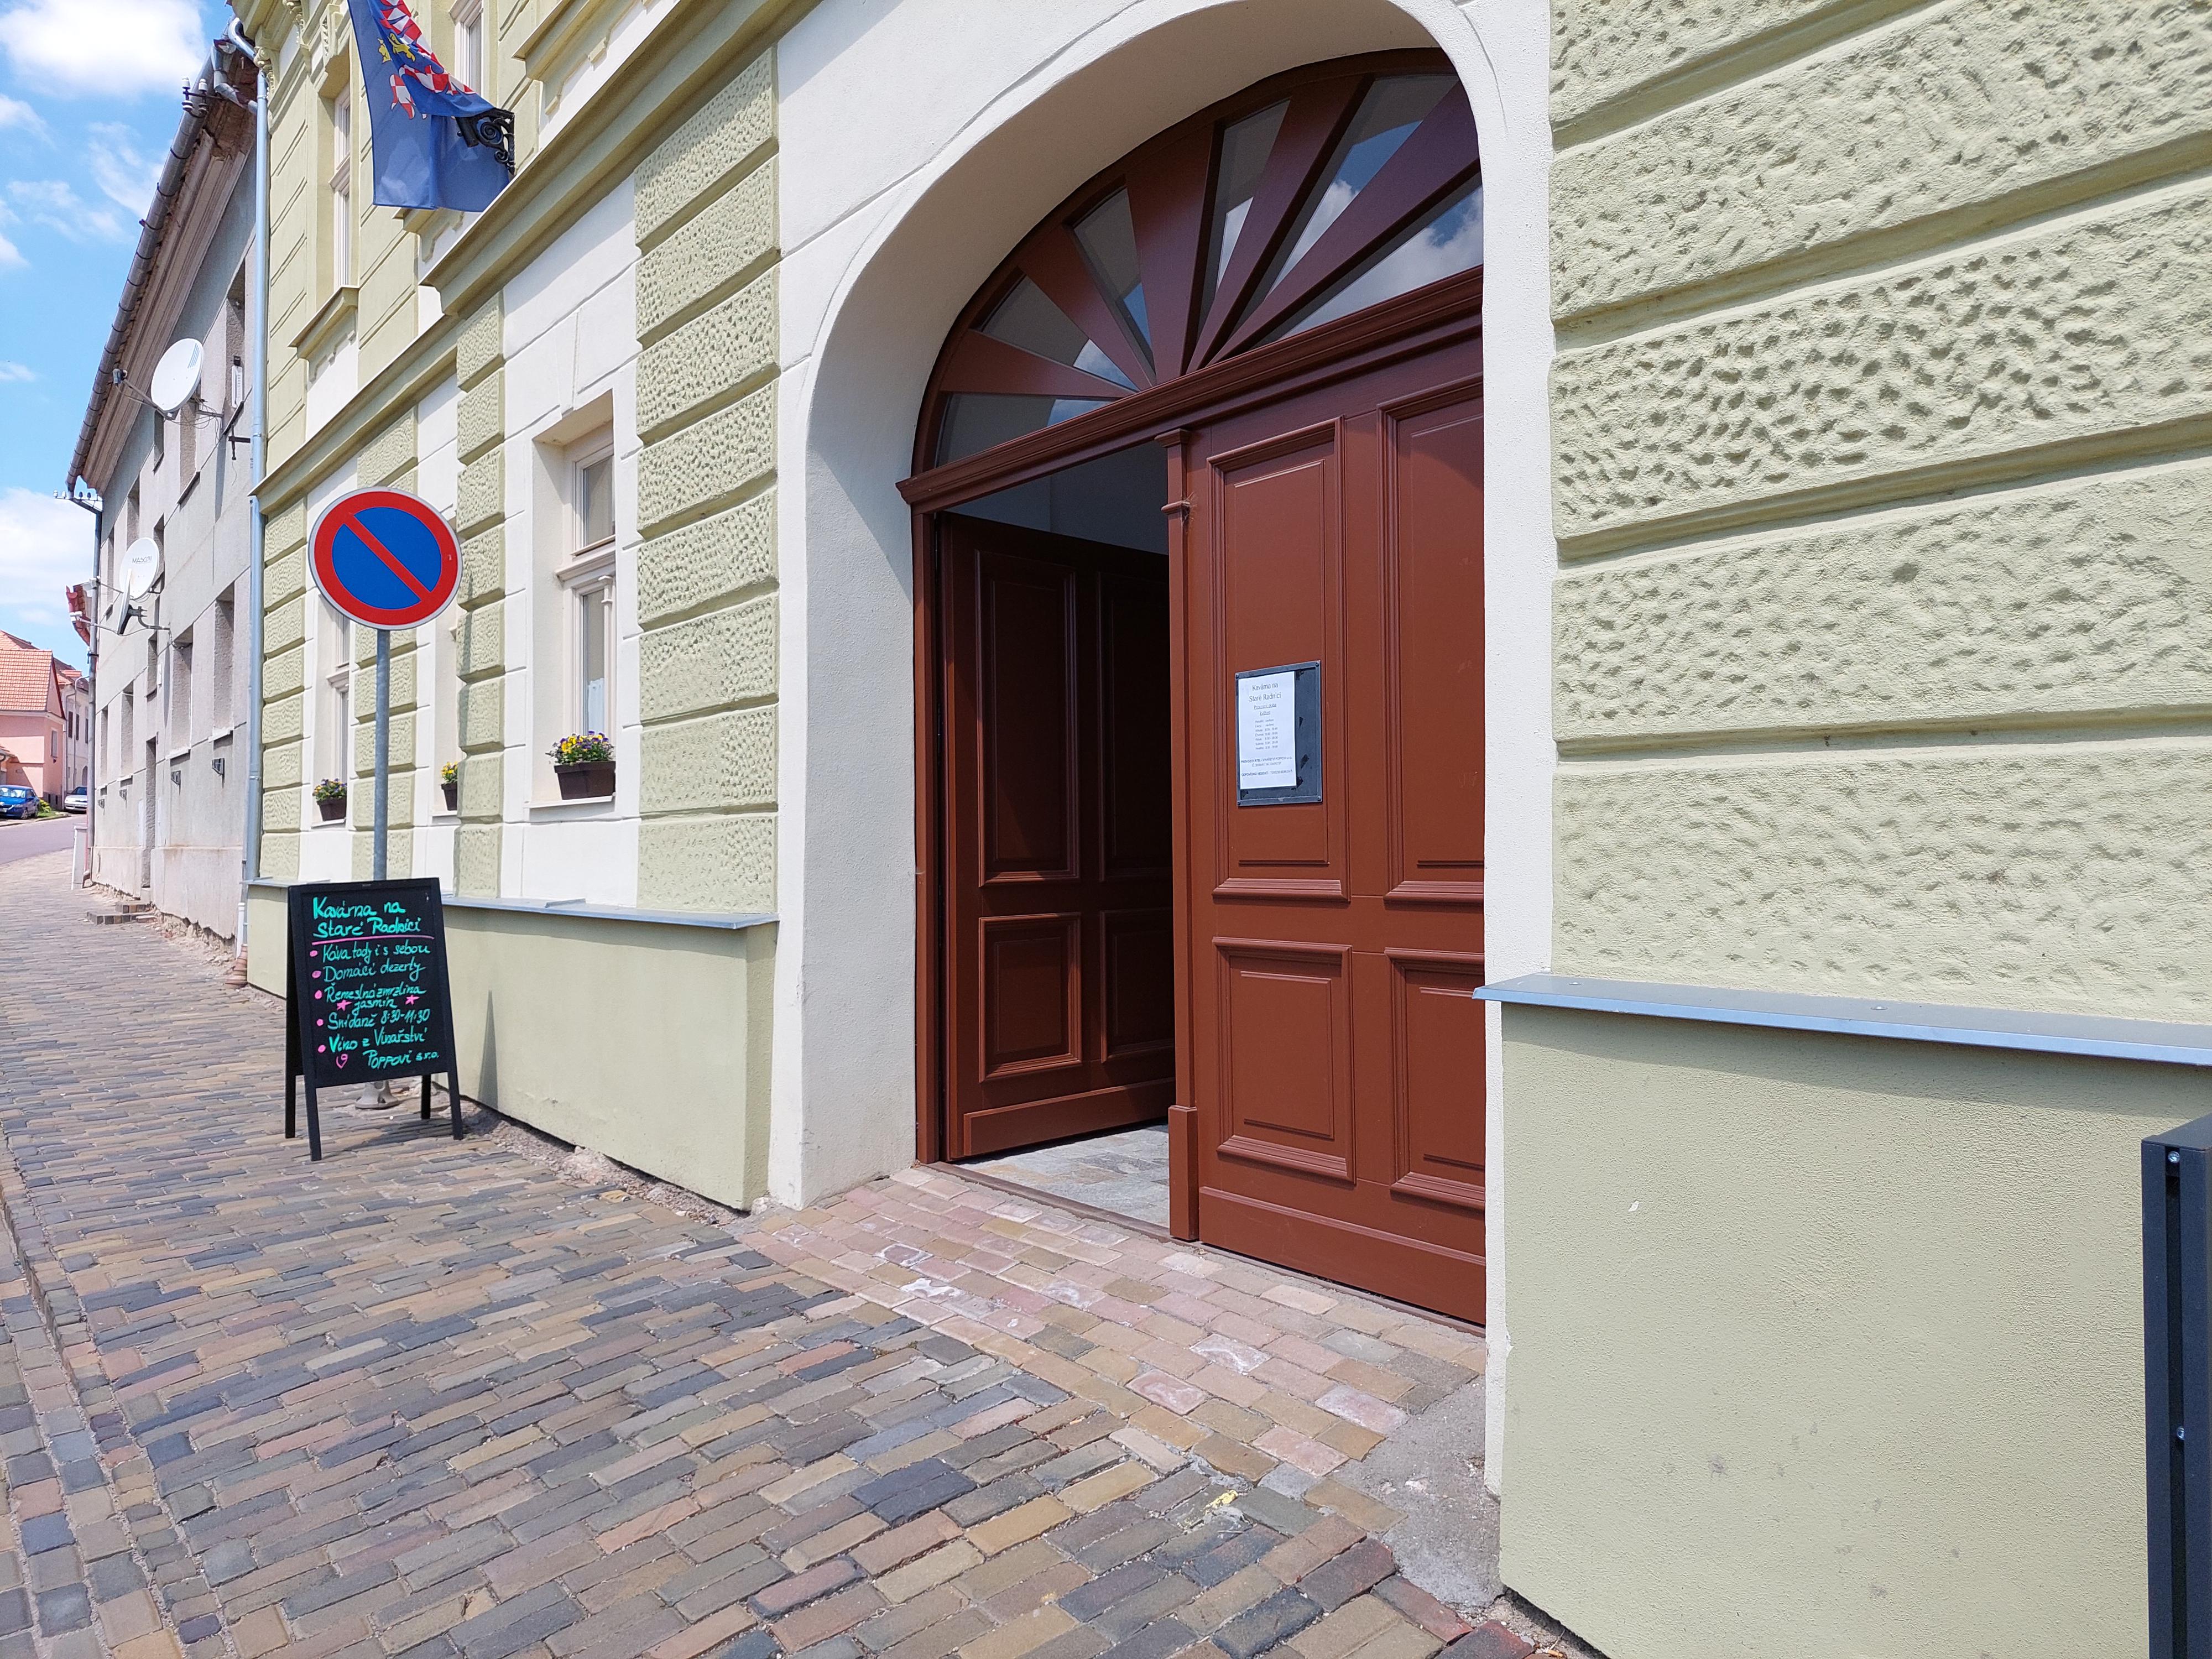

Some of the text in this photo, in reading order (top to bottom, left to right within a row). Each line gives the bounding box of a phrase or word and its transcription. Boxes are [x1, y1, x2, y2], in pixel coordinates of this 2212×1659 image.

[1263, 691, 1281, 700] Radnici
[313, 896, 406, 919] Kavárna na
[313, 917, 421, 938] Staré Radnici
[323, 939, 430, 964] Káva tady i s sebou
[323, 956, 426, 982] Domácí dezerty
[376, 981, 427, 998] zmrzlina
[362, 1038, 371, 1047] z
[374, 1025, 427, 1046] Vinařství
